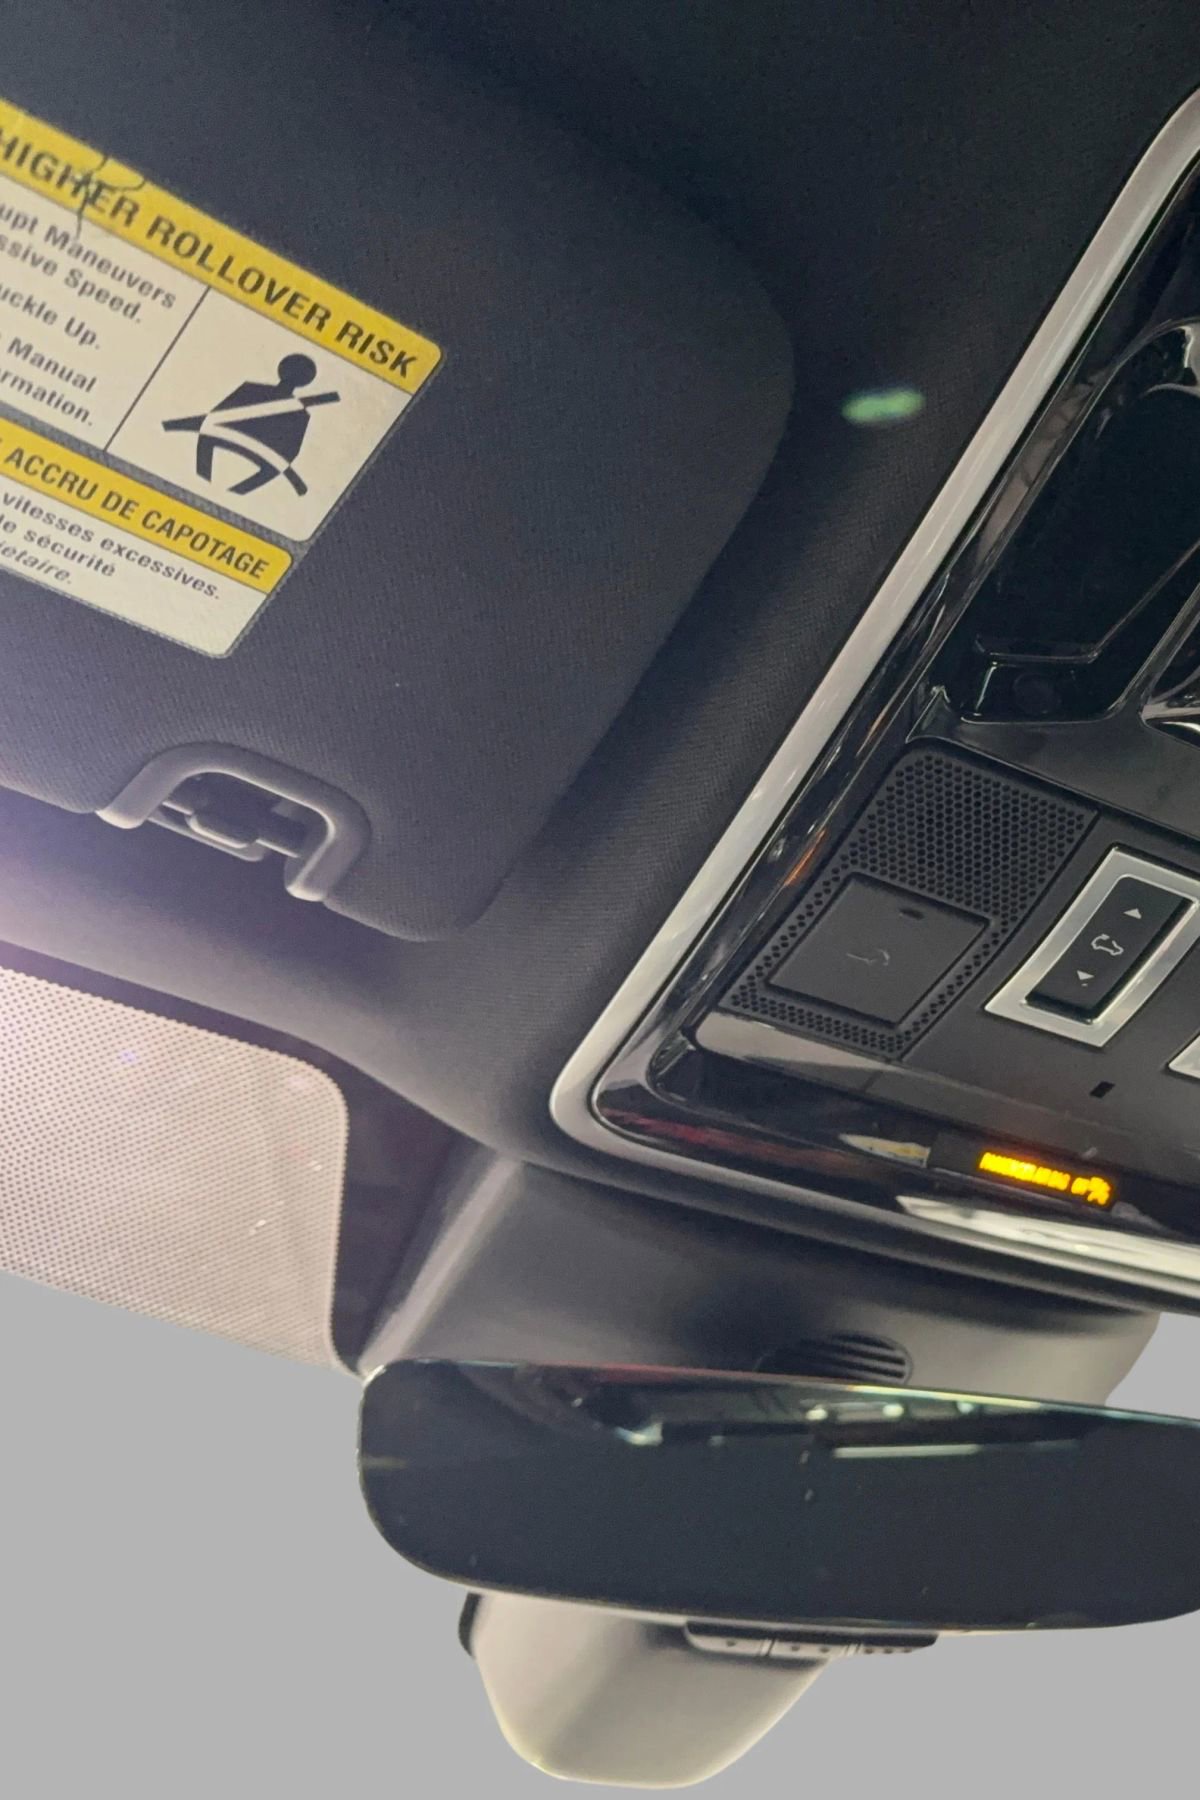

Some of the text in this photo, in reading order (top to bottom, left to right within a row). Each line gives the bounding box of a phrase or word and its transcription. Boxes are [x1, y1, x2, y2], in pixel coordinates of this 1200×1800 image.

[44, 225, 177, 309] Maneuvers
[64, 268, 141, 324] Speed.
[146, 215, 332, 332] ROLLOVER
[335, 320, 418, 379] RISK
[7, 336, 97, 393] Manual
[64, 316, 100, 350] Up.
[3, 492, 220, 600] vitesses excessives.
[4, 447, 270, 580] ACCRU DE CAPOTAGE
